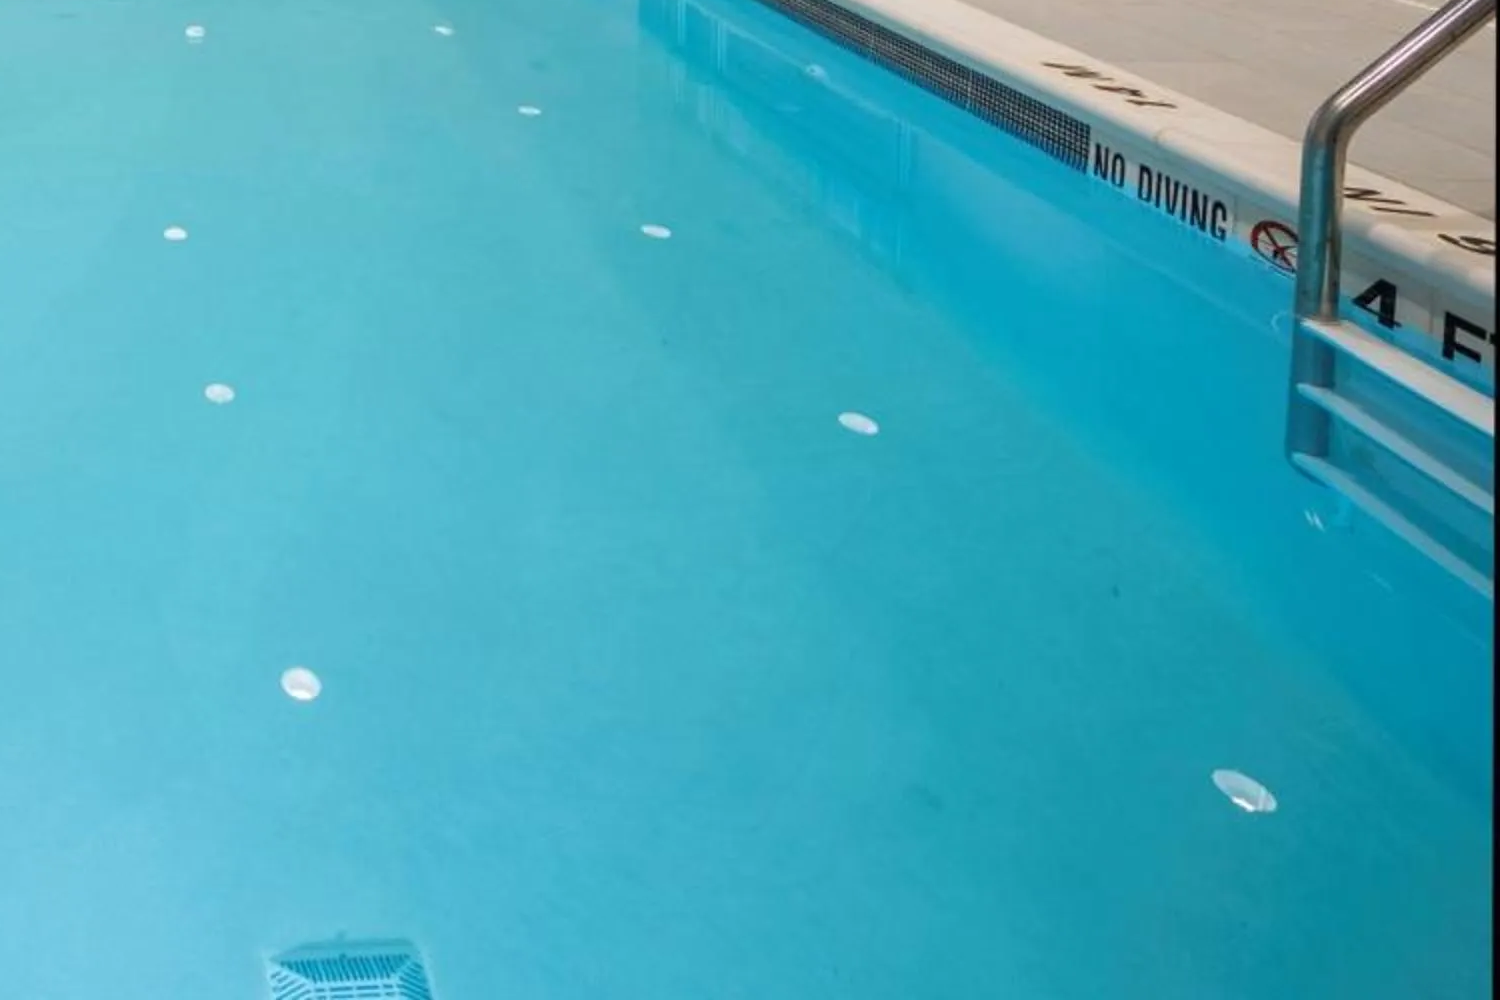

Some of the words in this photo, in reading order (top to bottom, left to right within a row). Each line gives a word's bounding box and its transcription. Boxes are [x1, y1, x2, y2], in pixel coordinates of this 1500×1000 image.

[1094, 141, 1126, 188] NO
[1137, 163, 1228, 242] DIVING
[1351, 278, 1403, 330] 4
[1442, 310, 1496, 364] F
